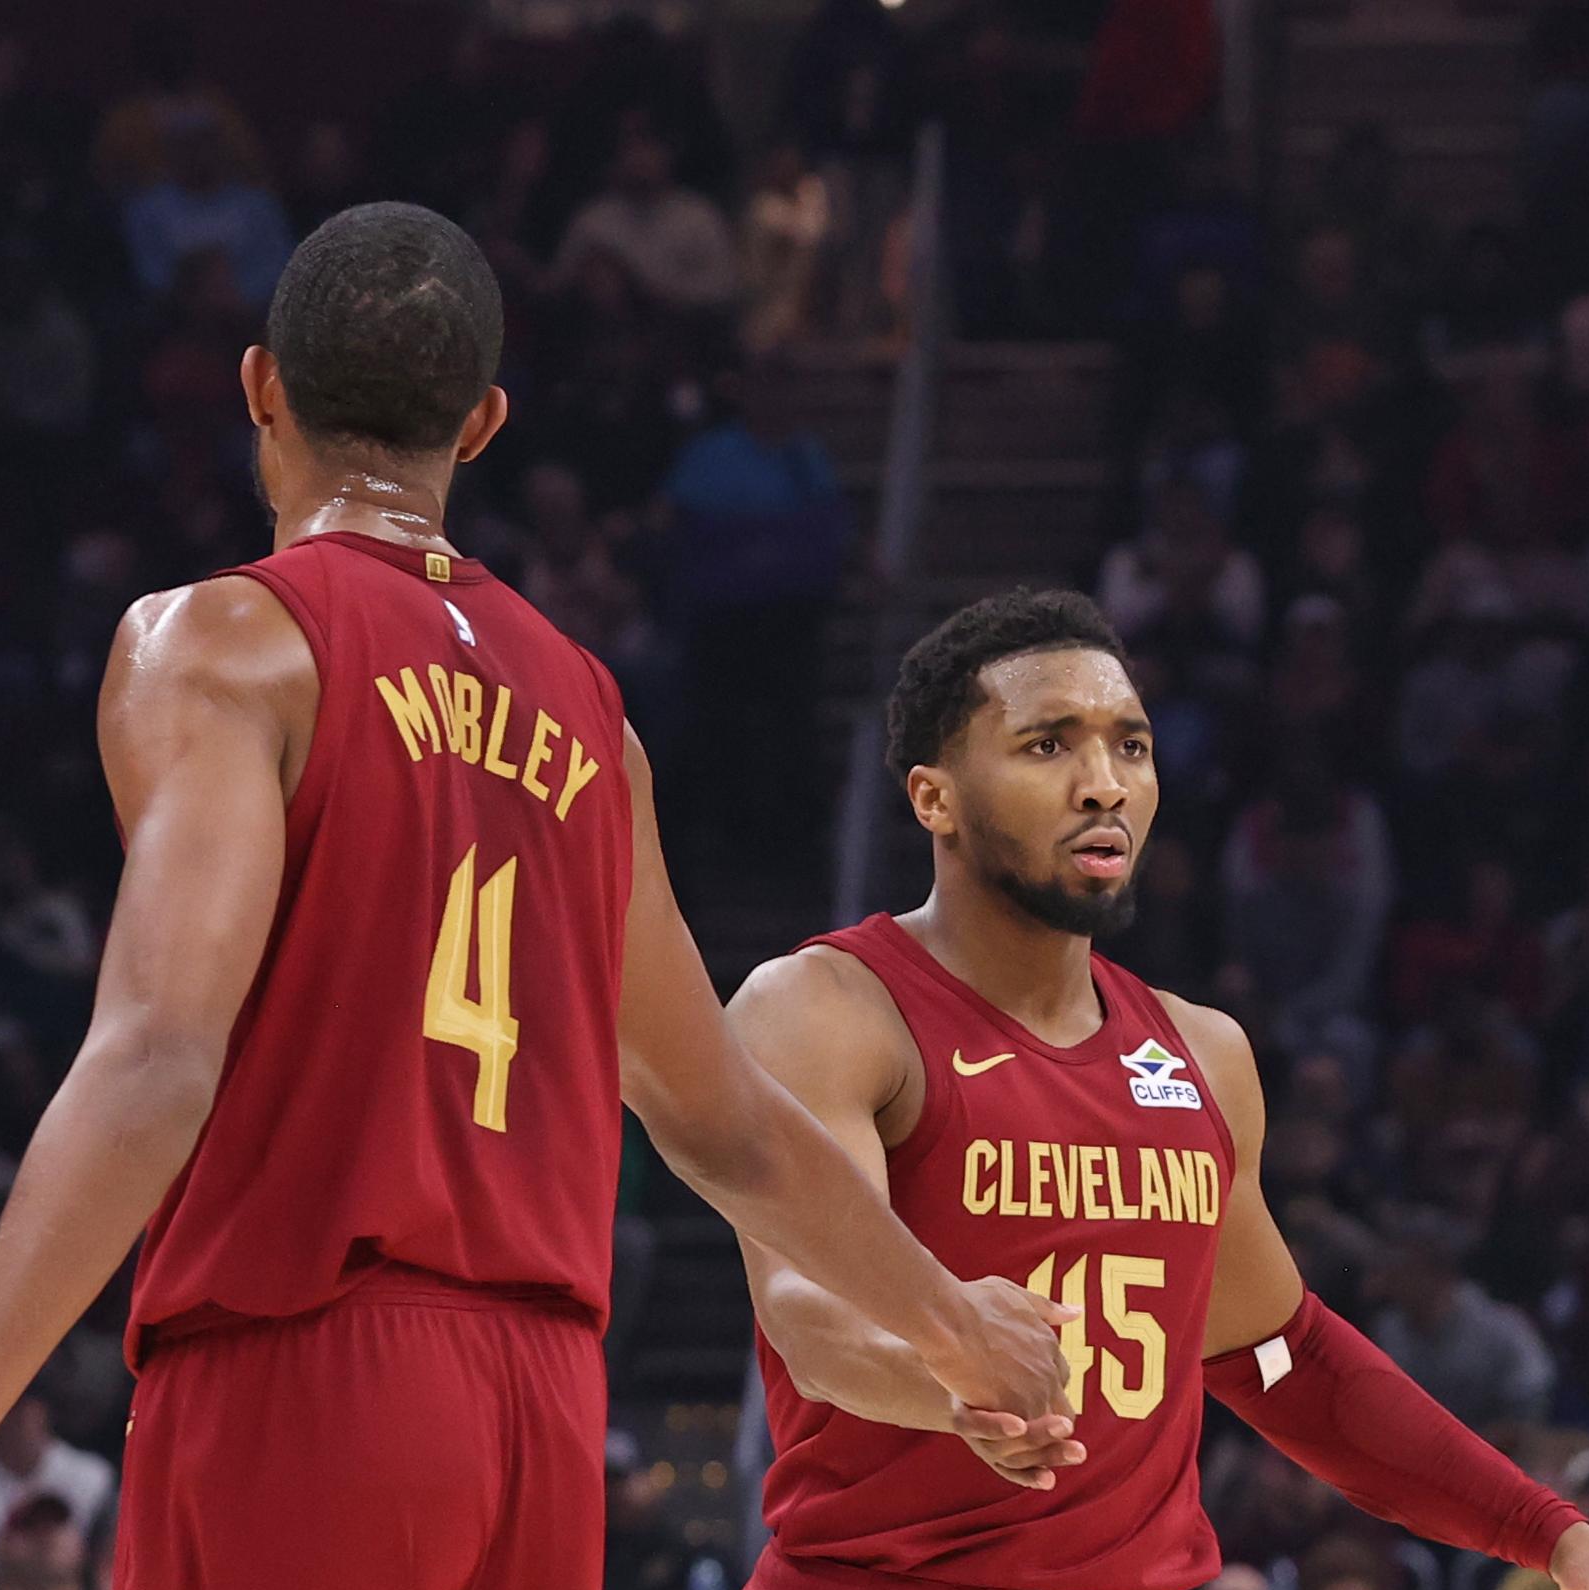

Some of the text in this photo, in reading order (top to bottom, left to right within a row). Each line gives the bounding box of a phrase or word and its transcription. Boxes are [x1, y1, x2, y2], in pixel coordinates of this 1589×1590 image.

[375, 663, 600, 822] MOBLEY
[422, 842, 520, 1134] 4
[1134, 1084, 1198, 1103] CLIFFS
[962, 1138, 1220, 1226] CLEVELAND
